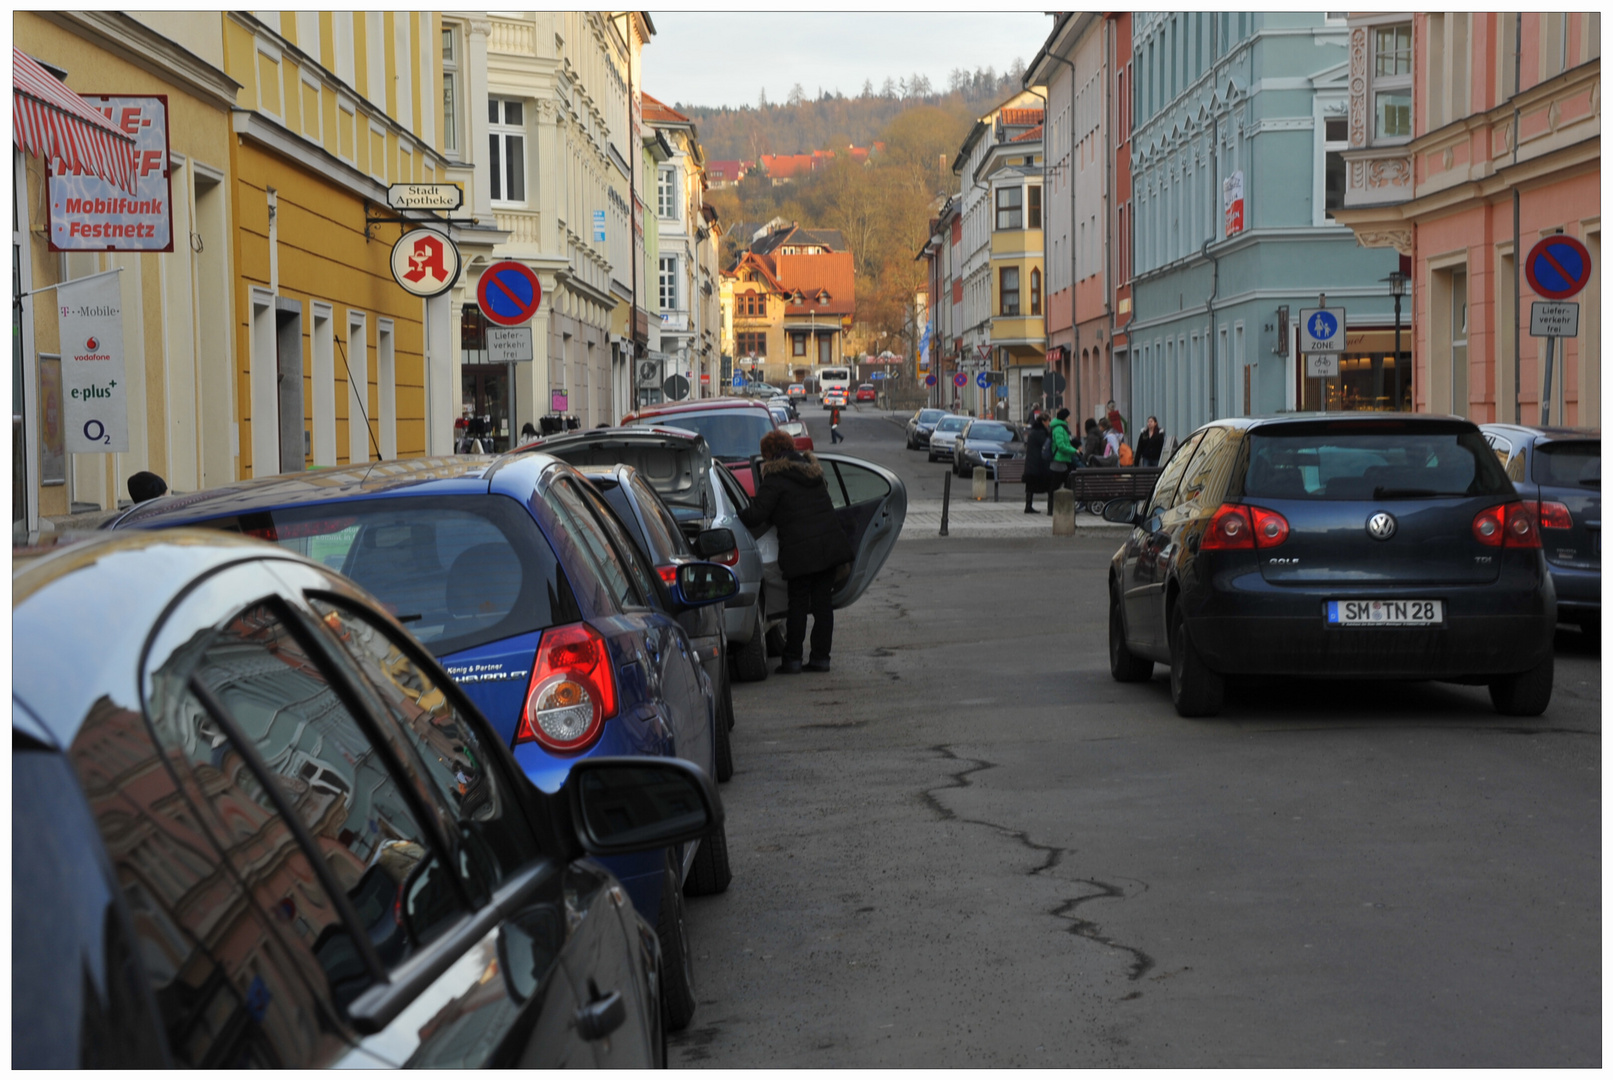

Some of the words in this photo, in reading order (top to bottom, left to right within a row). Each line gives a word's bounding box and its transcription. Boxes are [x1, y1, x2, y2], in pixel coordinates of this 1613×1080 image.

[408, 185, 439, 196] Stadt
[396, 195, 454, 207] Apotheke
[65, 197, 163, 215] Mobilfunk
[69, 221, 155, 238] Festnetz
[1542, 306, 1570, 315] Liefer-
[1539, 316, 1571, 324] verkehr
[1547, 325, 1561, 333] frei
[494, 331, 523, 340] Liefer-
[493, 341, 526, 349] verkehr
[1311, 341, 1334, 350] ZONE
[74, 353, 111, 361] vodafone
[503, 350, 518, 359] frei
[1345, 602, 1370, 620] SM
[1382, 602, 1407, 620] TN
[1411, 602, 1435, 620] 28
[447, 666, 467, 674] König
[468, 665, 474, 673] &
[475, 663, 503, 672] Partner
[452, 670, 528, 683] HEVROLET
